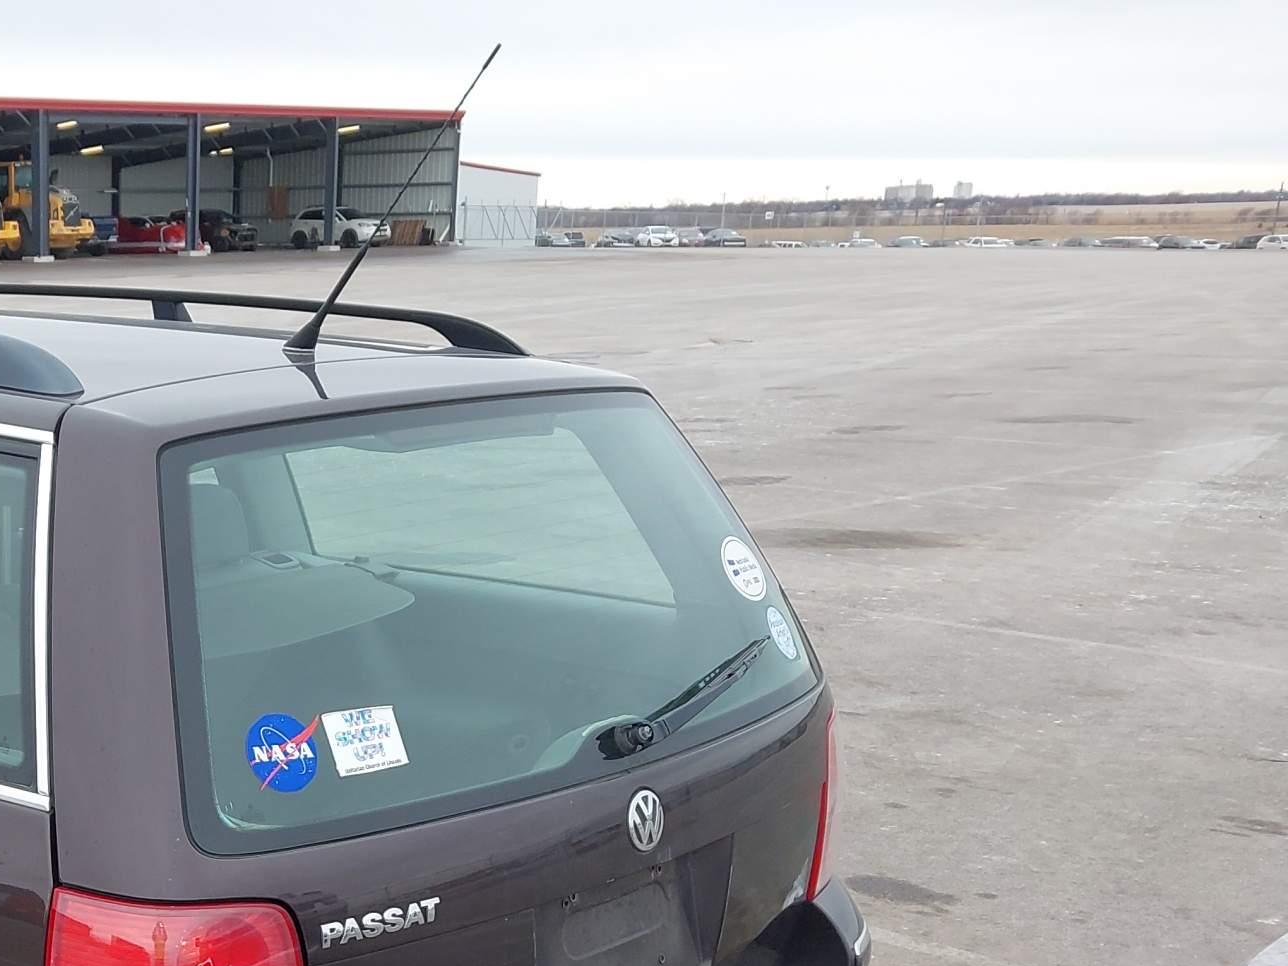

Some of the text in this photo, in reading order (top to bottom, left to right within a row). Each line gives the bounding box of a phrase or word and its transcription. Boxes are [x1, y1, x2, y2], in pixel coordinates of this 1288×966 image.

[334, 723, 390, 746] SHOW
[252, 742, 314, 763] NASA
[320, 896, 441, 949] PASSAT
